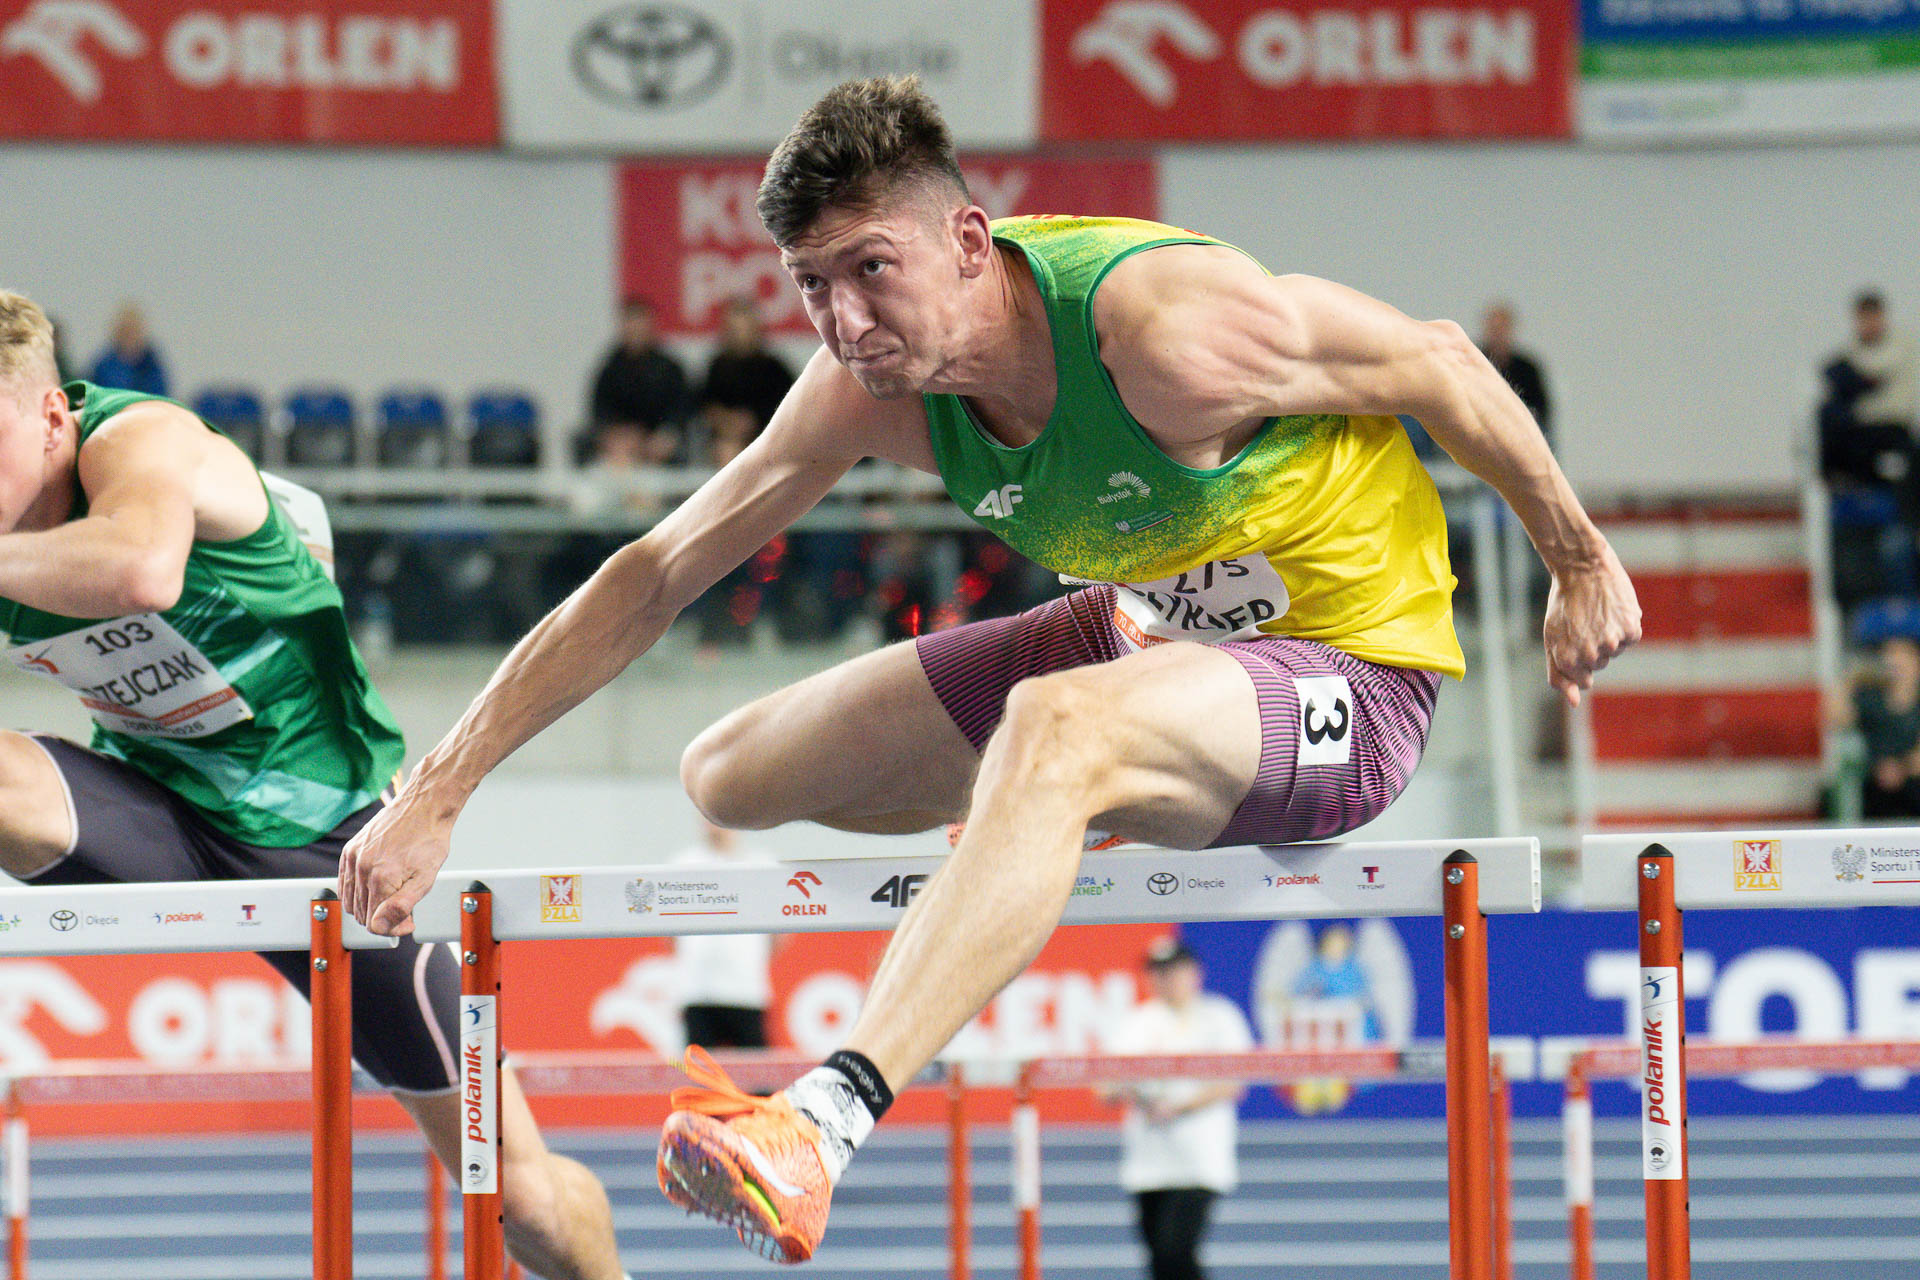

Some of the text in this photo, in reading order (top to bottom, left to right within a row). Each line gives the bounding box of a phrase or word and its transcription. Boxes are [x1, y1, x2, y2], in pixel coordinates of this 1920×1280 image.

[164, 13, 458, 89] ORLEN
[1240, 10, 1534, 86] ORLEN
[973, 484, 1023, 519] 4F
[85, 622, 153, 656] 103
[81, 652, 206, 707] ZEJCZAK
[1305, 697, 1348, 745] 3
[1871, 861, 1906, 873] Sportu
[658, 881, 719, 891] Ministerstwo
[1188, 878, 1225, 889] Okęcie
[1277, 873, 1321, 887] polanik
[1736, 874, 1778, 888] PZLA
[871, 874, 929, 907] 4F
[1071, 886, 1103, 896] XMED
[658, 895, 689, 905] Sportu
[696, 893, 739, 904] Turystyki
[543, 906, 578, 920] PZLA
[782, 904, 827, 916] ORLEN
[86, 914, 119, 927] Okęcie
[165, 911, 204, 924] polanik
[128, 978, 312, 1061] ORL
[1643, 1017, 1671, 1126] polanik
[464, 1042, 488, 1144] polanik
